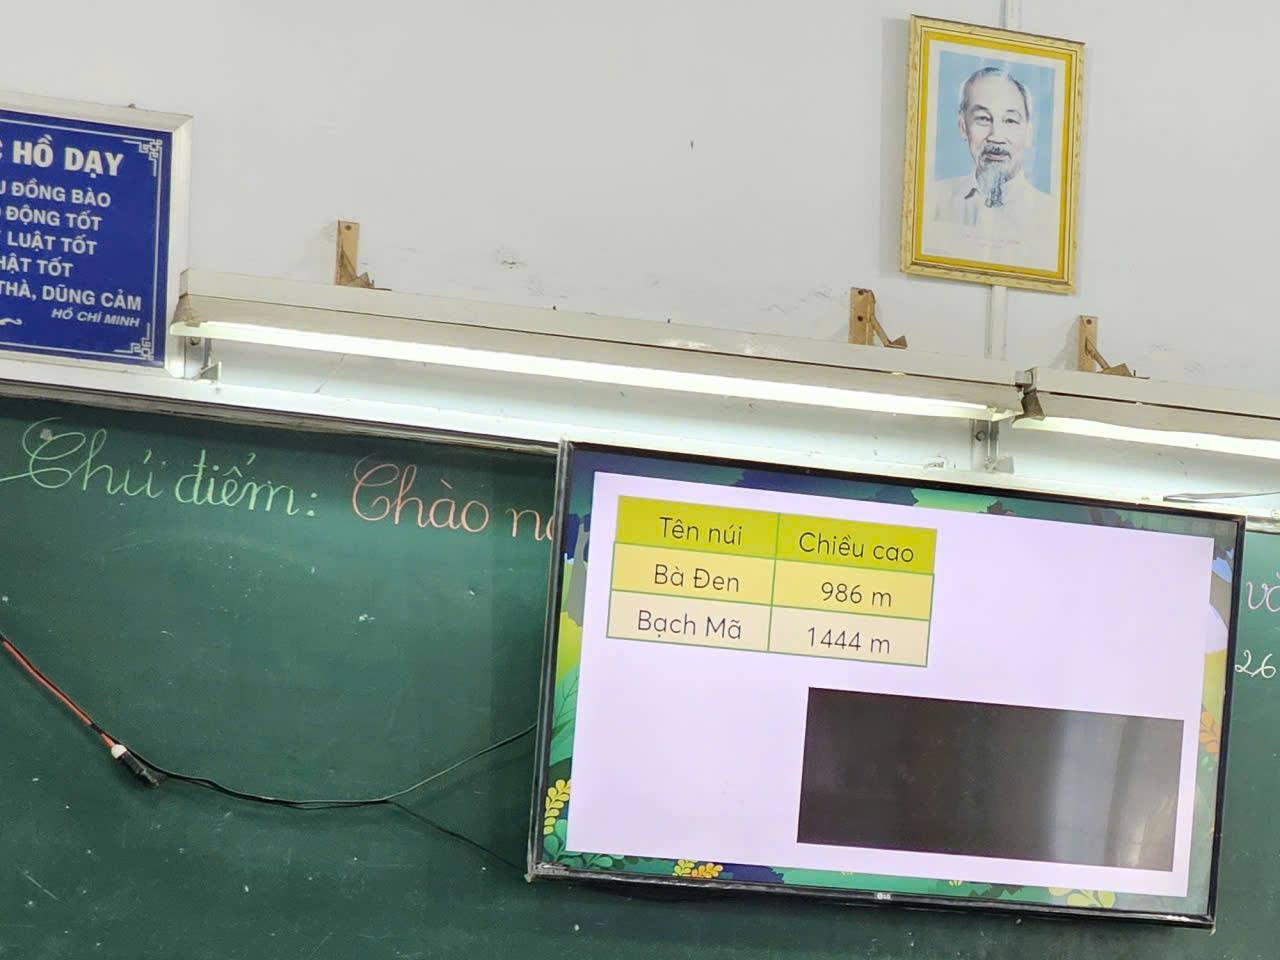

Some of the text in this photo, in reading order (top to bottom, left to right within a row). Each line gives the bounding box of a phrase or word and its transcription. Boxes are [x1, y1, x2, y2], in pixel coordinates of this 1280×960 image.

[13, 134, 54, 168] HỒ
[64, 147, 124, 178] DẠY
[11, 178, 66, 202] ĐỒNG
[71, 187, 111, 208] BÀO
[6, 204, 60, 226] ĐỘNG
[65, 210, 102, 231] TỐT
[7, 230, 98, 255] LUẬT TỐT
[36, 256, 74, 278] TỐT
[42, 284, 95, 306] DŨNG
[101, 289, 142, 311] CẢM
[104, 314, 140, 327] MINH
[0, 417, 163, 498] Chủ
[175, 449, 318, 516] điểm:
[352, 453, 490, 533] Chào
[659, 517, 914, 563] Tên núi Chiều cao
[654, 564, 892, 607] Bà Đen 986 m
[638, 610, 891, 654] Bạch Mã 1444 m
[1234, 649, 1277, 679] 26
